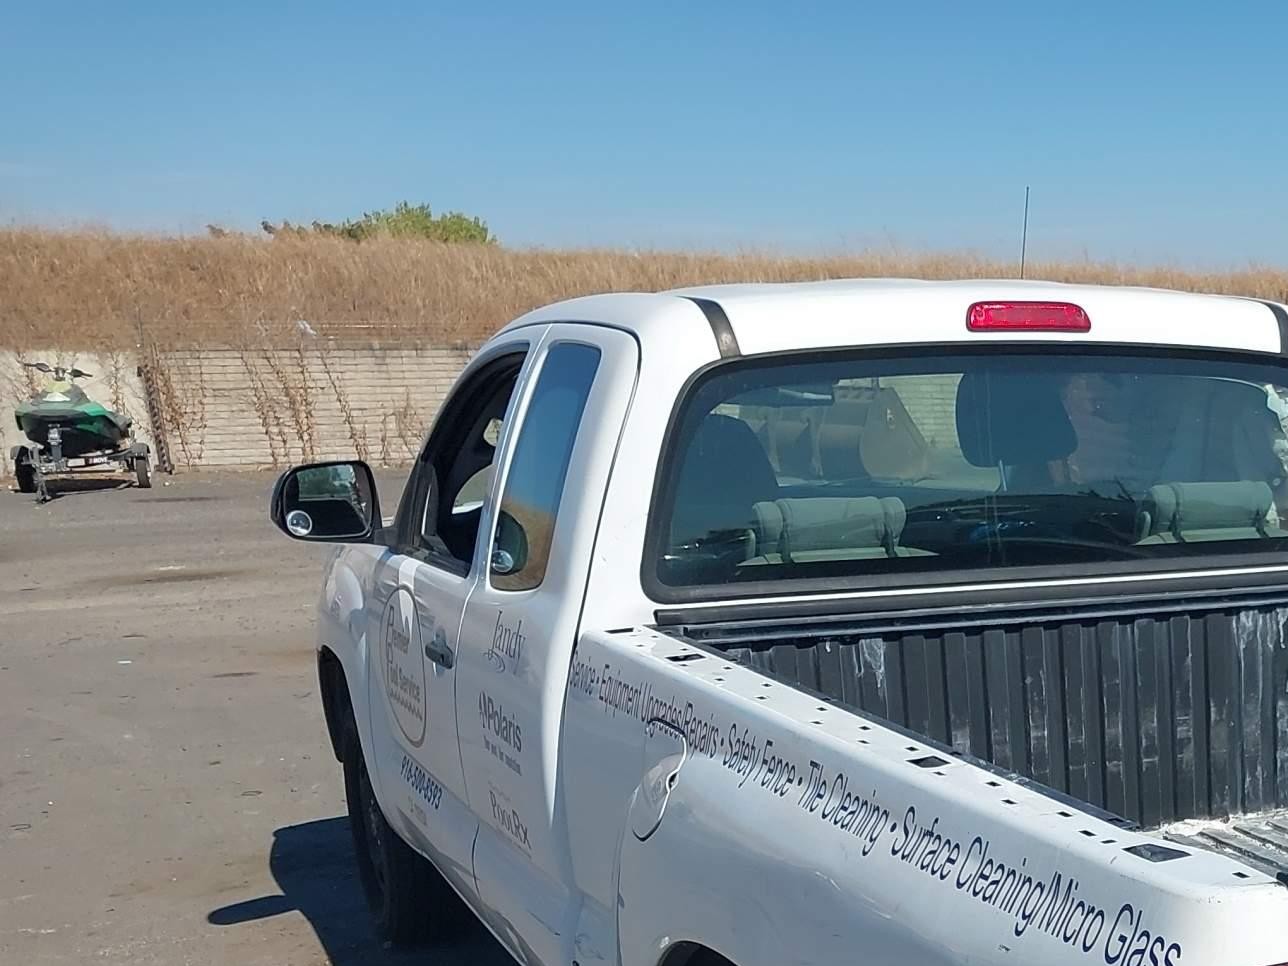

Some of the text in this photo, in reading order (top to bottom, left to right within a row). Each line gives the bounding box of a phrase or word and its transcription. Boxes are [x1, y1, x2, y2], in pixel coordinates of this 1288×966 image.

[486, 695, 522, 752] Polaris
[570, 650, 597, 696] Service
[599, 663, 643, 719] Equipment
[722, 723, 761, 789] Safety
[753, 739, 796, 797] Fence
[798, 760, 827, 813] Tile
[821, 772, 890, 857] Cleaning
[891, 806, 961, 881] Surface
[956, 836, 1105, 953] Cleaning/Micro
